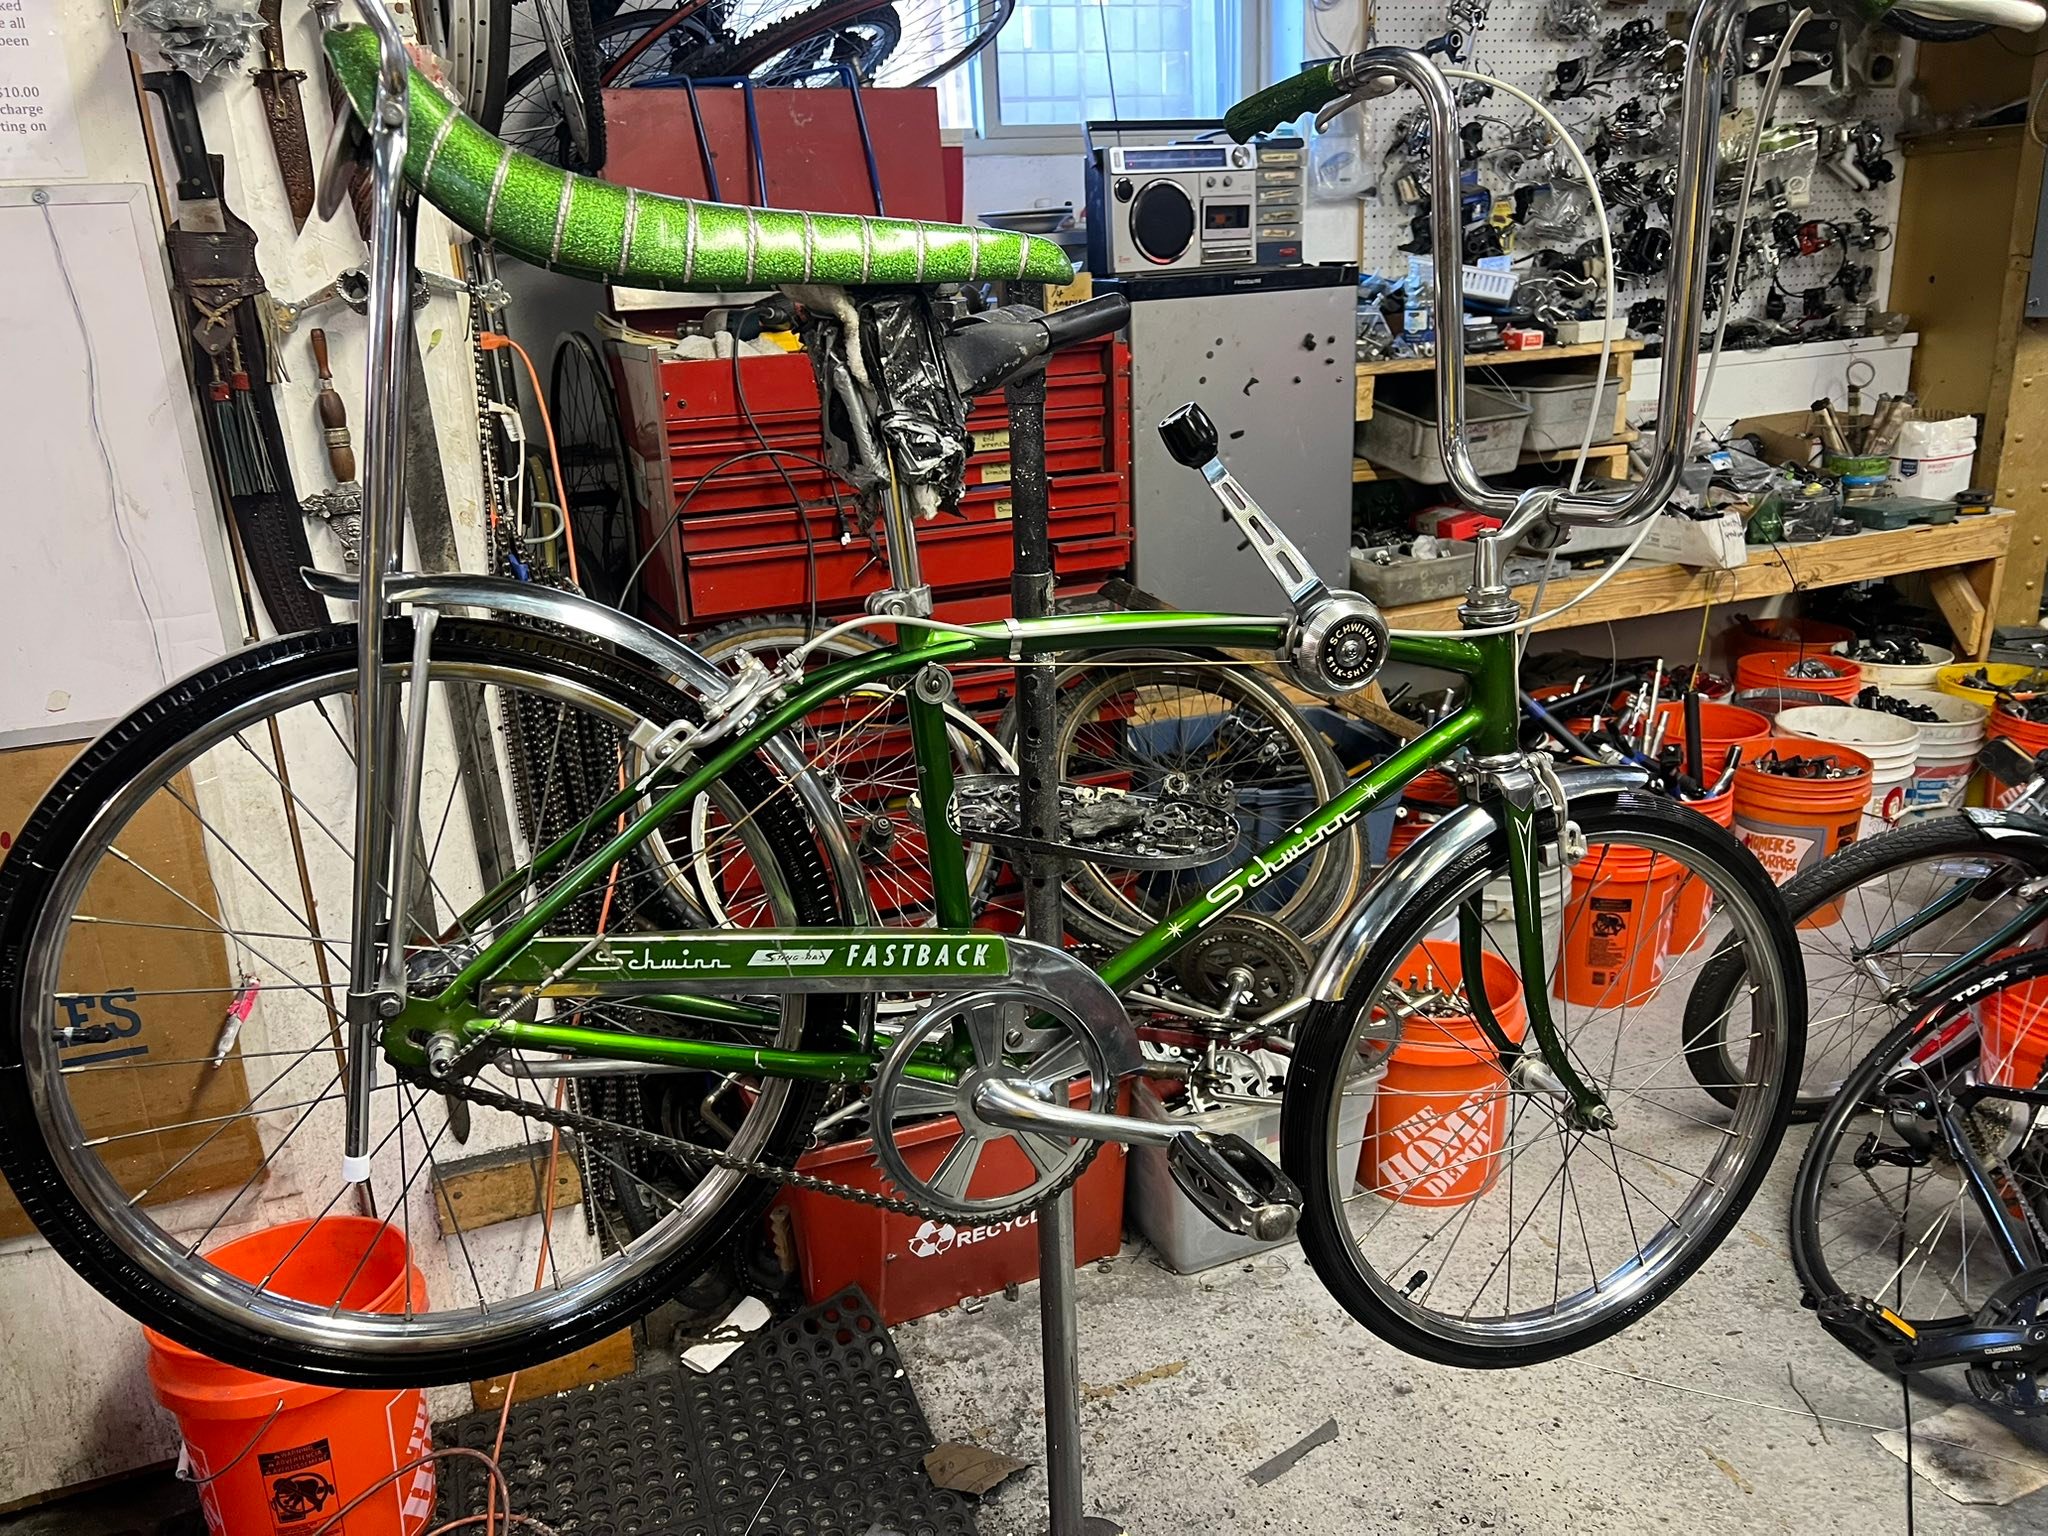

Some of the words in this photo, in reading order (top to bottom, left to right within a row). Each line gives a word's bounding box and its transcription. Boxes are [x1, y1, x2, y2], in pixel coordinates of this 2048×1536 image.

[10, 16, 26, 29] all
[0, 103, 44, 117] charge
[30, 122, 47, 131] on
[1198, 811, 1361, 929] Schwinn
[577, 948, 732, 971] Schwinn
[846, 943, 990, 967] FASTBACK
[1951, 971, 2009, 1002] TD24
[1390, 1105, 1441, 1146] THE
[1423, 1125, 1492, 1199] DEPOT
